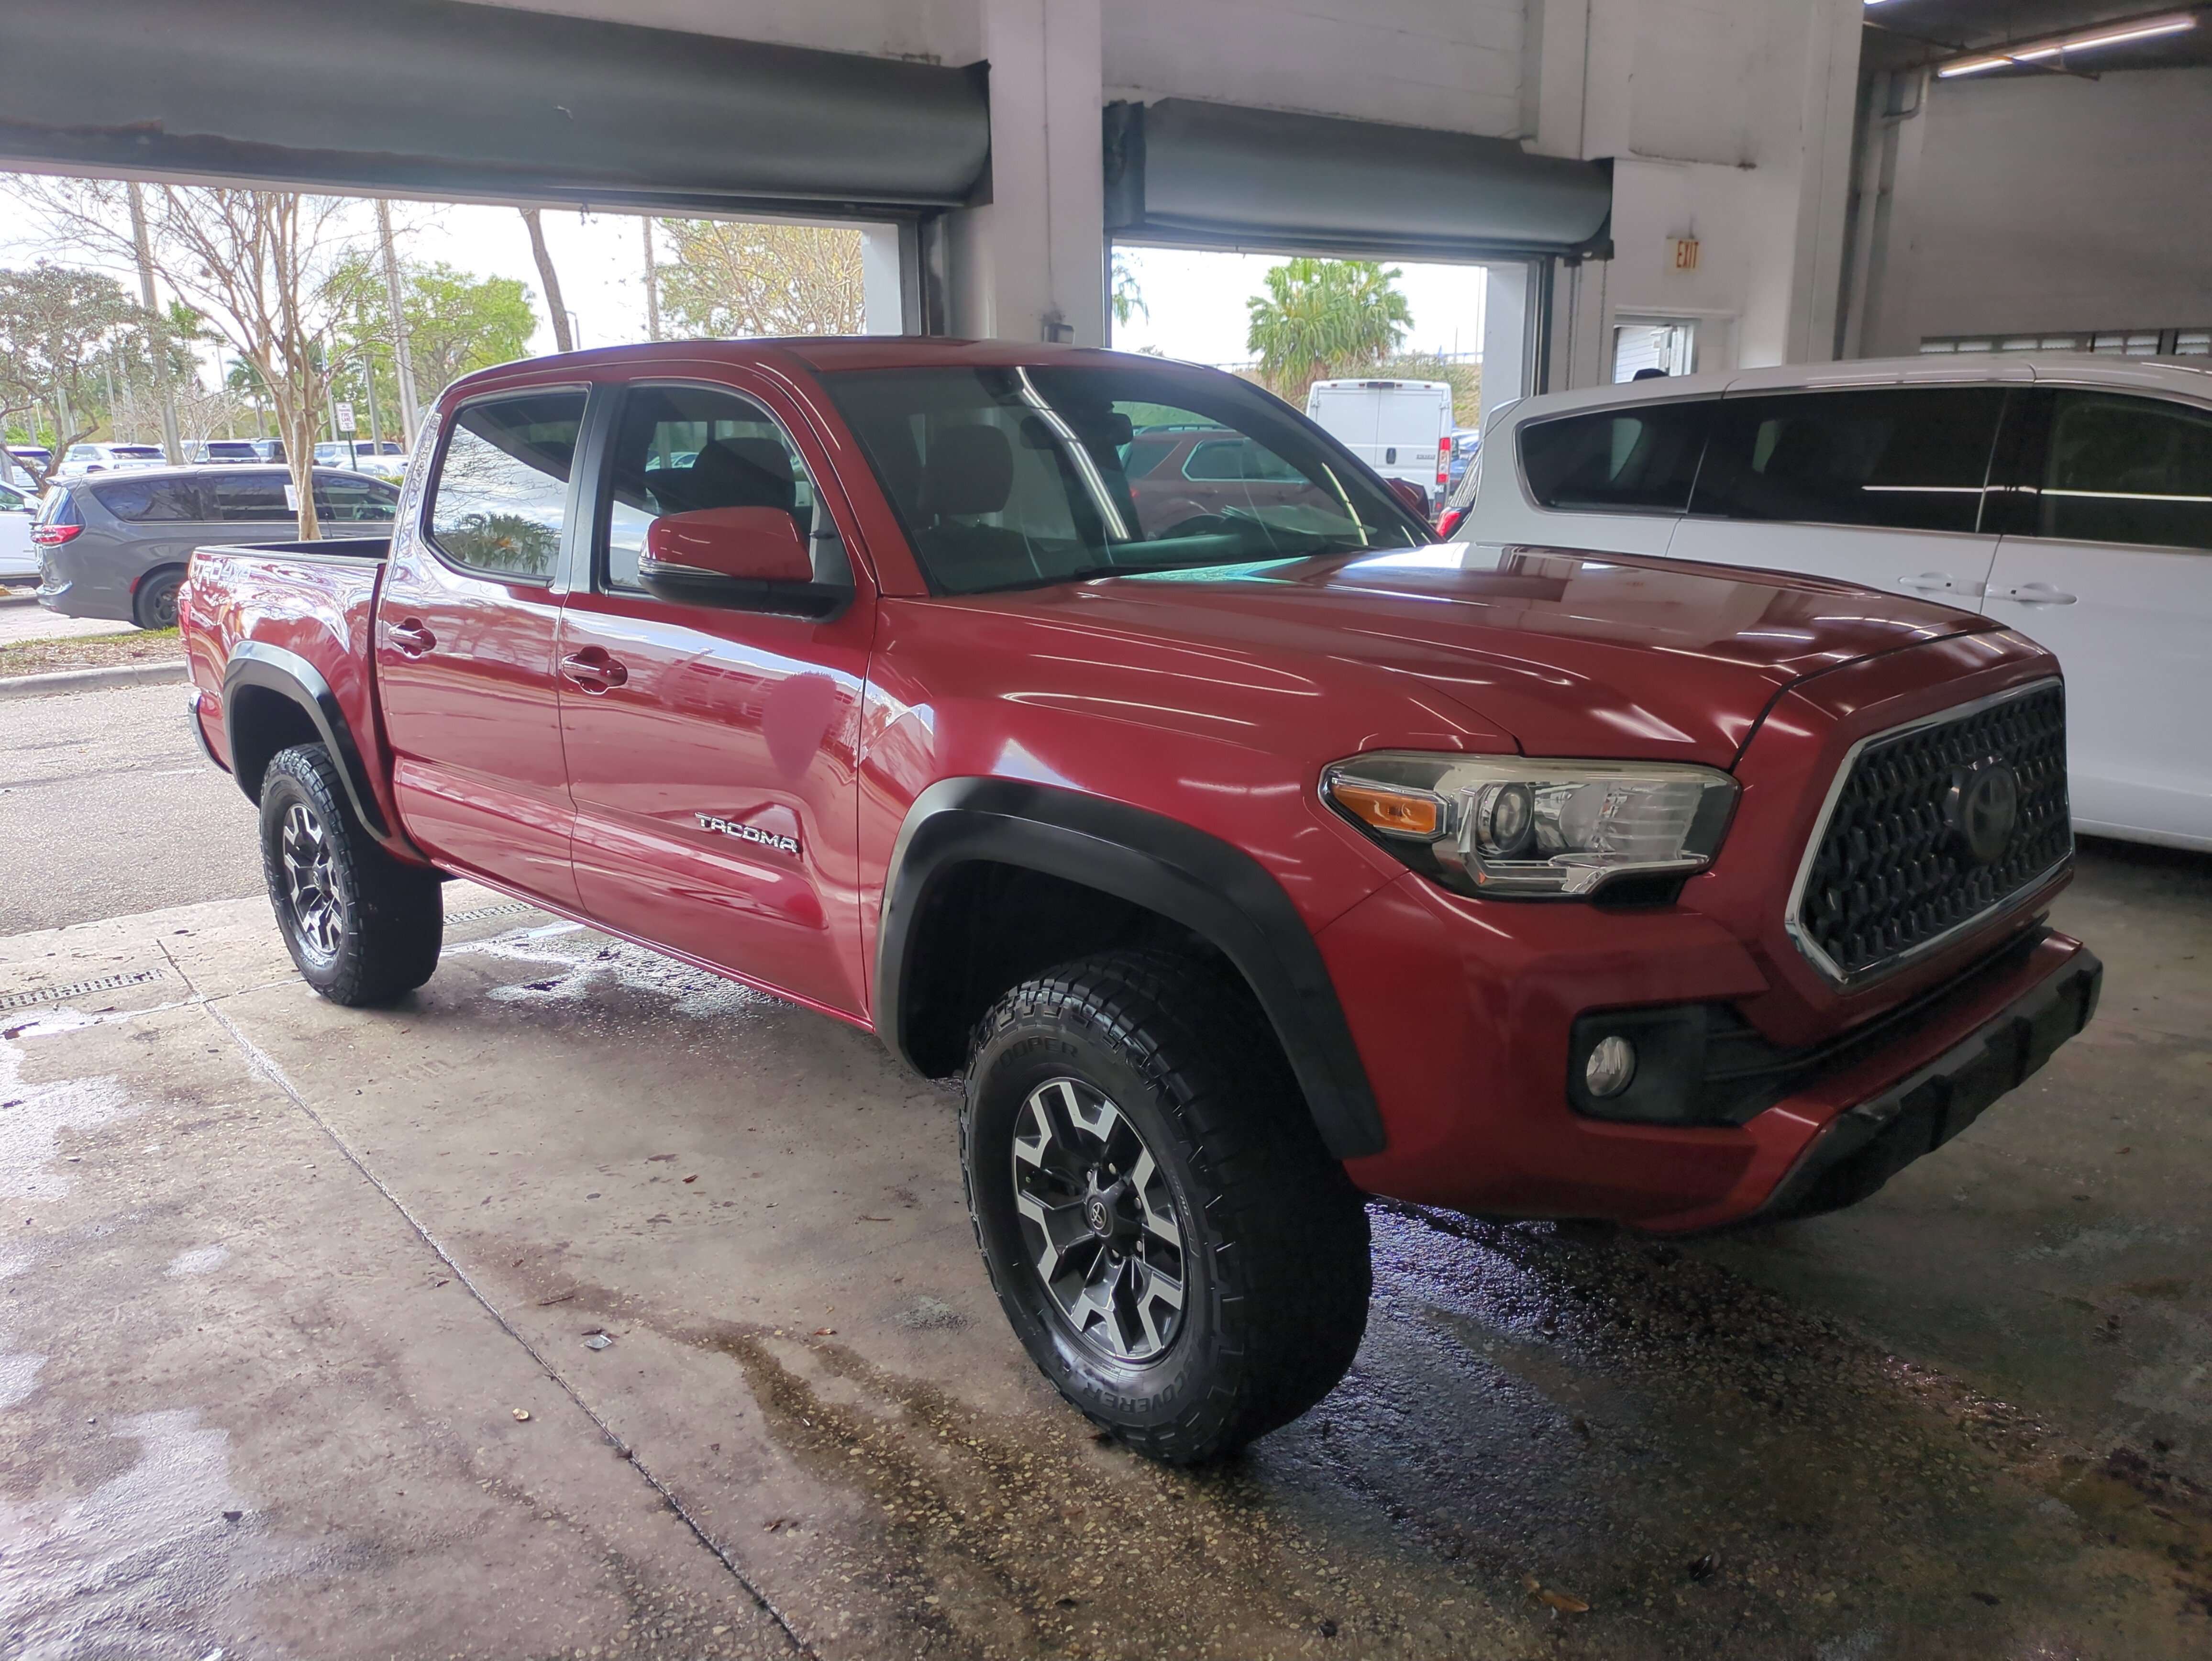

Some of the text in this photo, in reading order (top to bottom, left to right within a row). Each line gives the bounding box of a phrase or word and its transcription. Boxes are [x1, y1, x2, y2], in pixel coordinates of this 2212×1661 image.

[1676, 241, 1699, 268] EXIT
[695, 812, 802, 853] TACOMA
[990, 1036, 1079, 1082] COOPER
